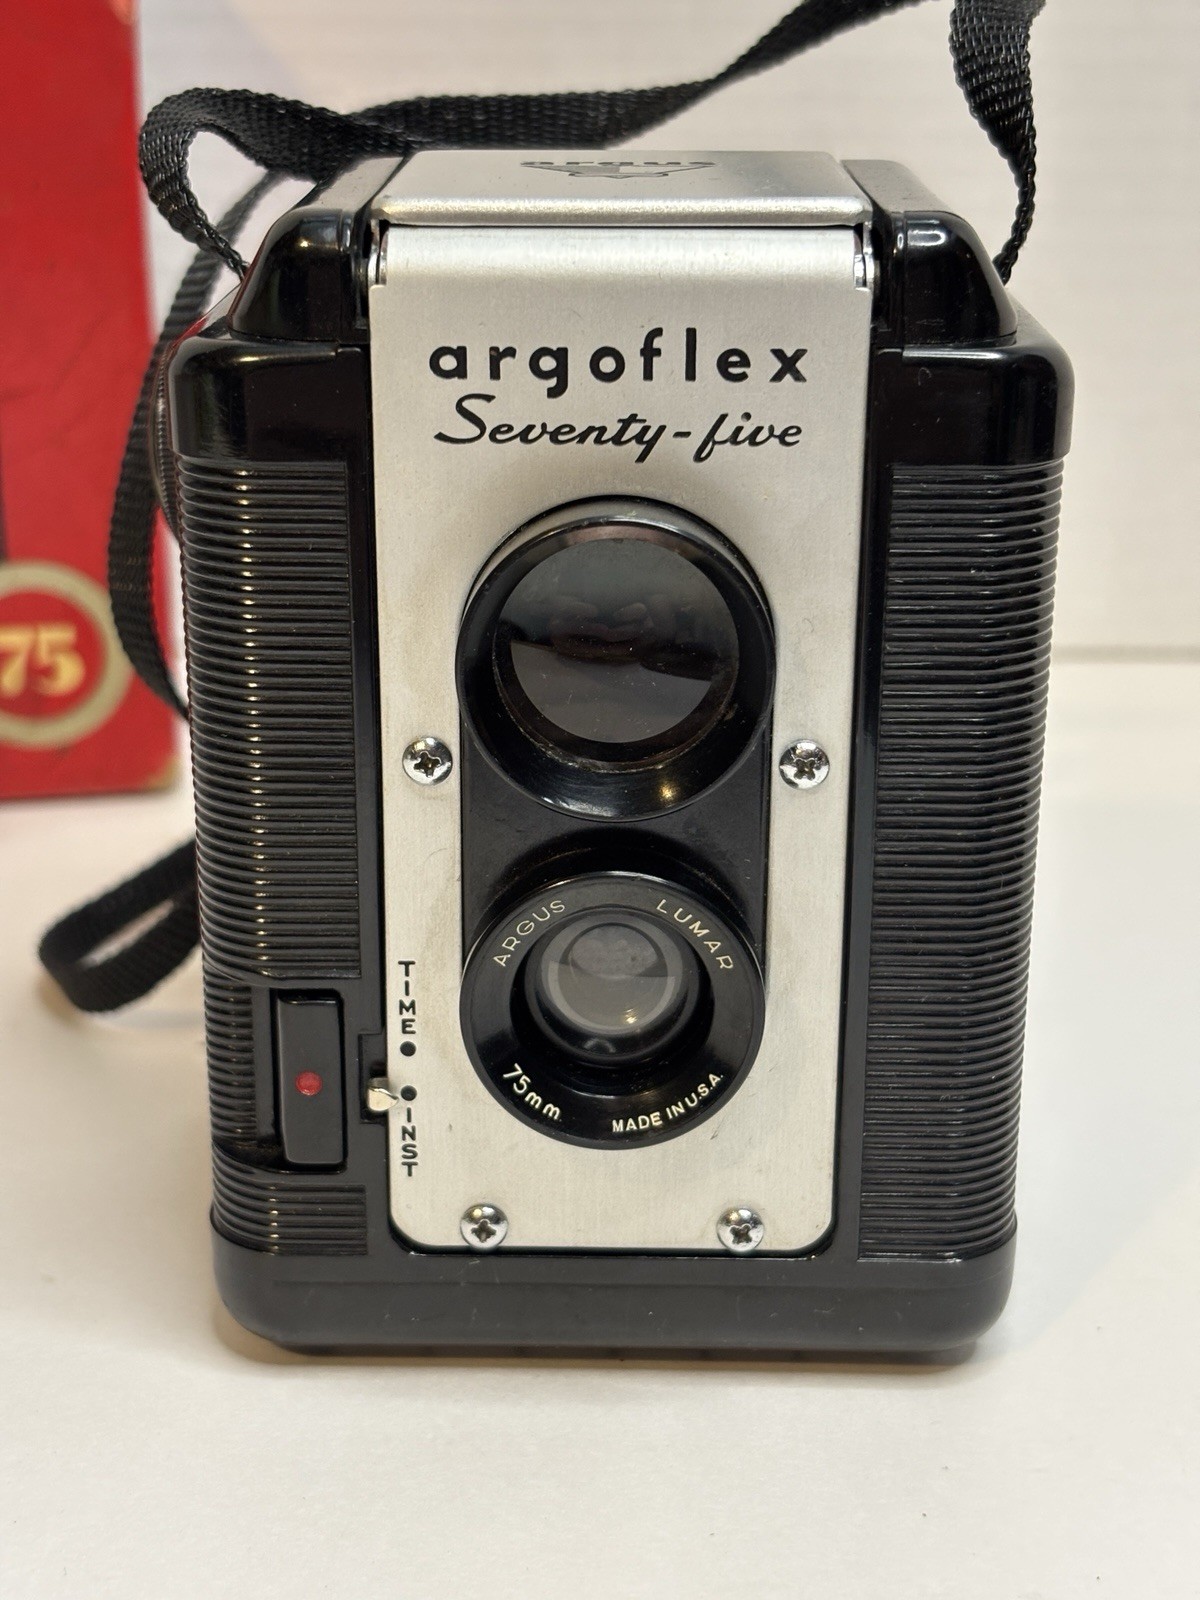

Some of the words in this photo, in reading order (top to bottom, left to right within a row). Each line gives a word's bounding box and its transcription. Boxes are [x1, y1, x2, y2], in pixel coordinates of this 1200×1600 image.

[429, 327, 808, 399] argoflex
[434, 393, 802, 463] Seventy-five
[0, 622, 86, 697] 75
[493, 900, 566, 967] ARGUS
[656, 899, 734, 970] LUMAR
[398, 960, 416, 1035] TIME
[502, 1063, 562, 1121] 75mm
[612, 1112, 661, 1133] MADE
[665, 1101, 685, 1120] IN
[684, 1072, 724, 1107] U.S.A.
[401, 1107, 419, 1177] INST
